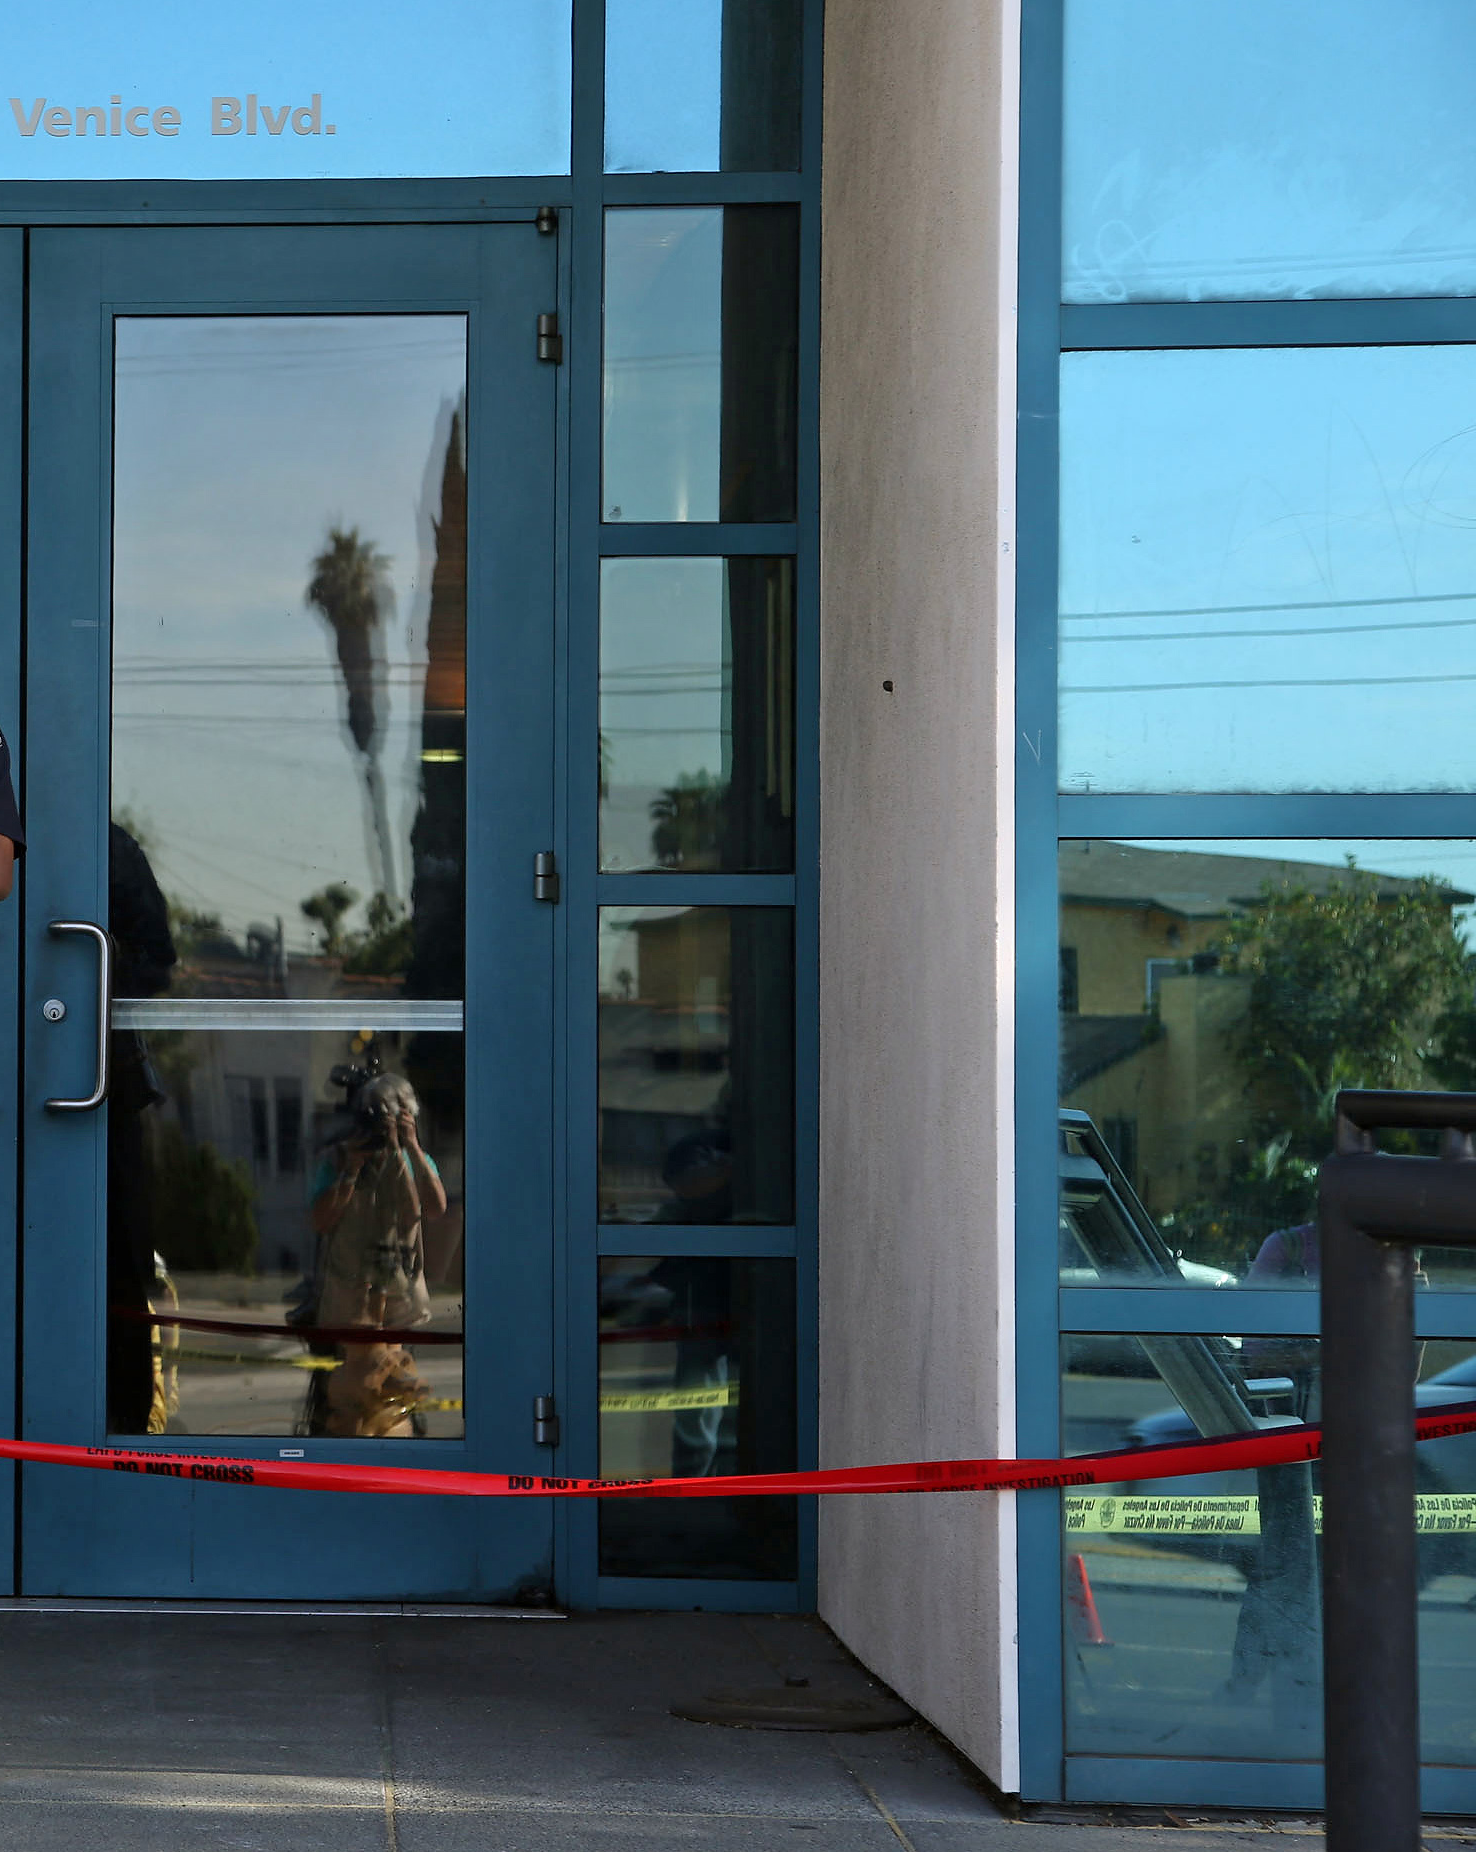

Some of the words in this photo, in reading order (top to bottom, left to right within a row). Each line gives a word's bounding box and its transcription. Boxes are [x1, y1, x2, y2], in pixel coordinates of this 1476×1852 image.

[9, 95, 181, 138] Venice
[210, 94, 336, 137] Blvd.
[113, 1461, 139, 1473] DO
[145, 1462, 183, 1477] NOT
[191, 1464, 255, 1483] CROSS
[508, 1476, 534, 1490] DO
[541, 1478, 580, 1490] NOT
